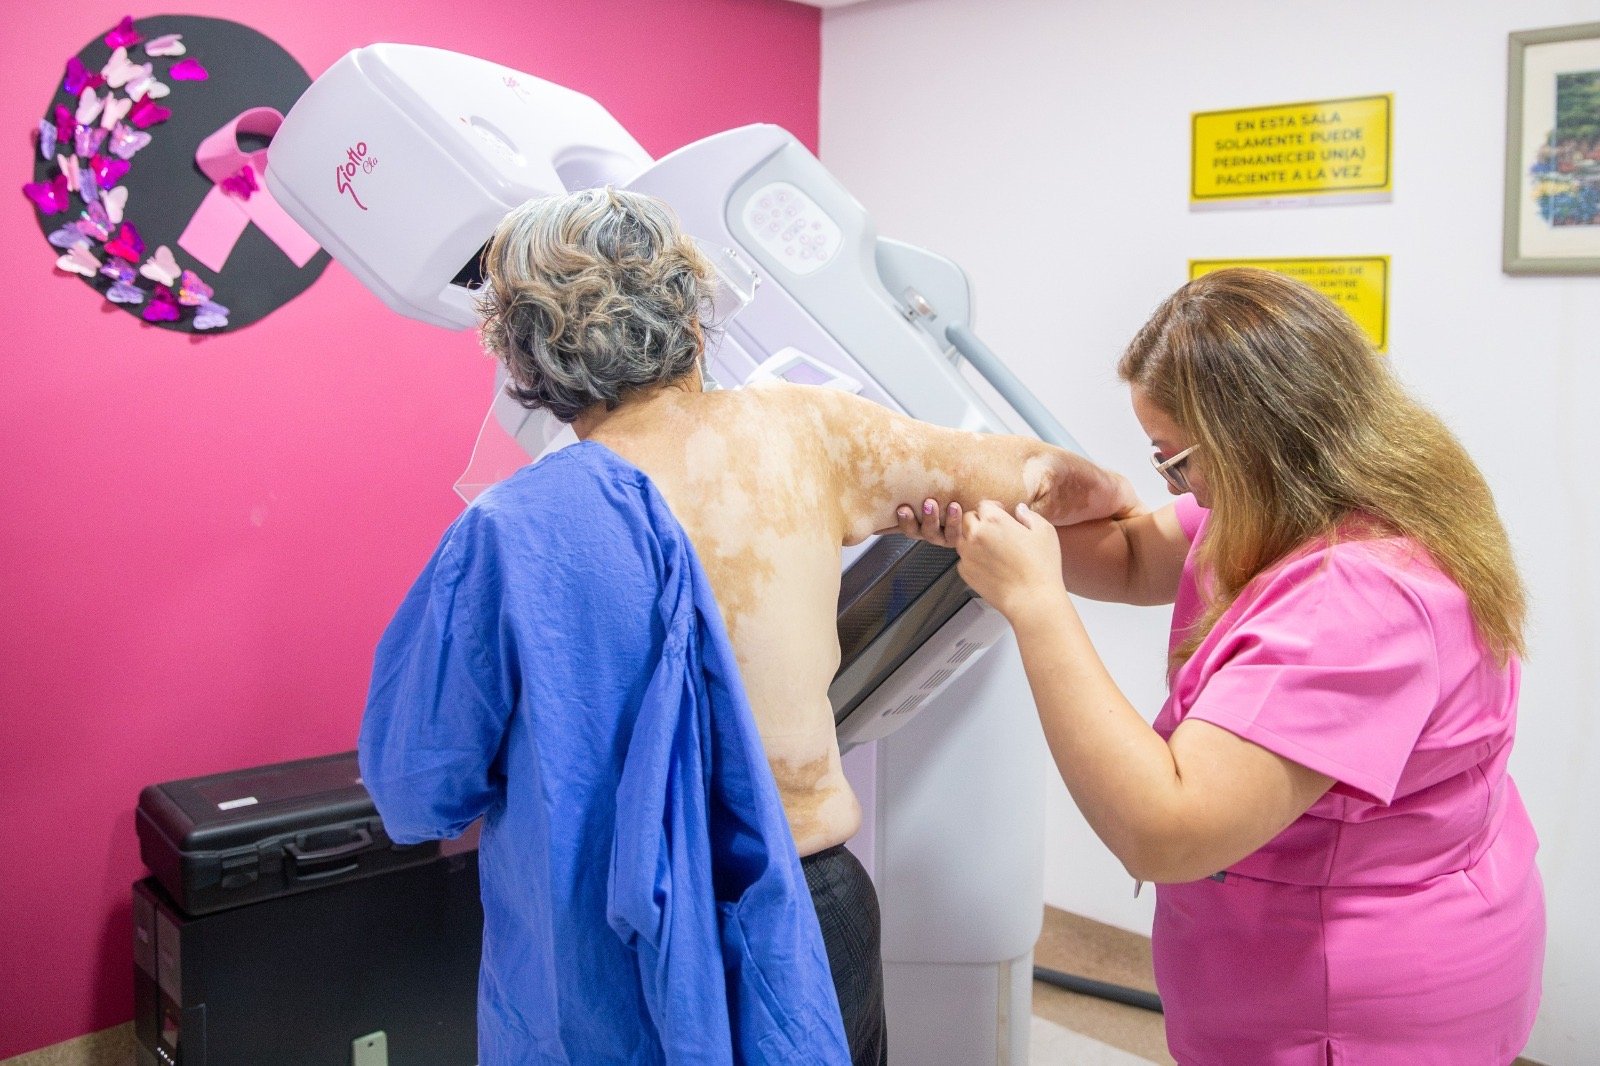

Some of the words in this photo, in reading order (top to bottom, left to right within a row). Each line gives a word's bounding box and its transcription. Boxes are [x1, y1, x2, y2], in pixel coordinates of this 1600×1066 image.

[1236, 119, 1255, 131] EN
[1260, 116, 1296, 129] ESTA
[1301, 111, 1341, 125] SALA
[1215, 134, 1304, 150] SOLAMENTE
[1310, 128, 1363, 143] PUEDE
[1213, 152, 1315, 168] PERMANECER
[1321, 147, 1365, 161] UN(A)
[1216, 170, 1286, 185] PACIENTE
[1292, 169, 1303, 180] A
[1307, 168, 1326, 180] LA
[1332, 166, 1361, 178] VEZ
